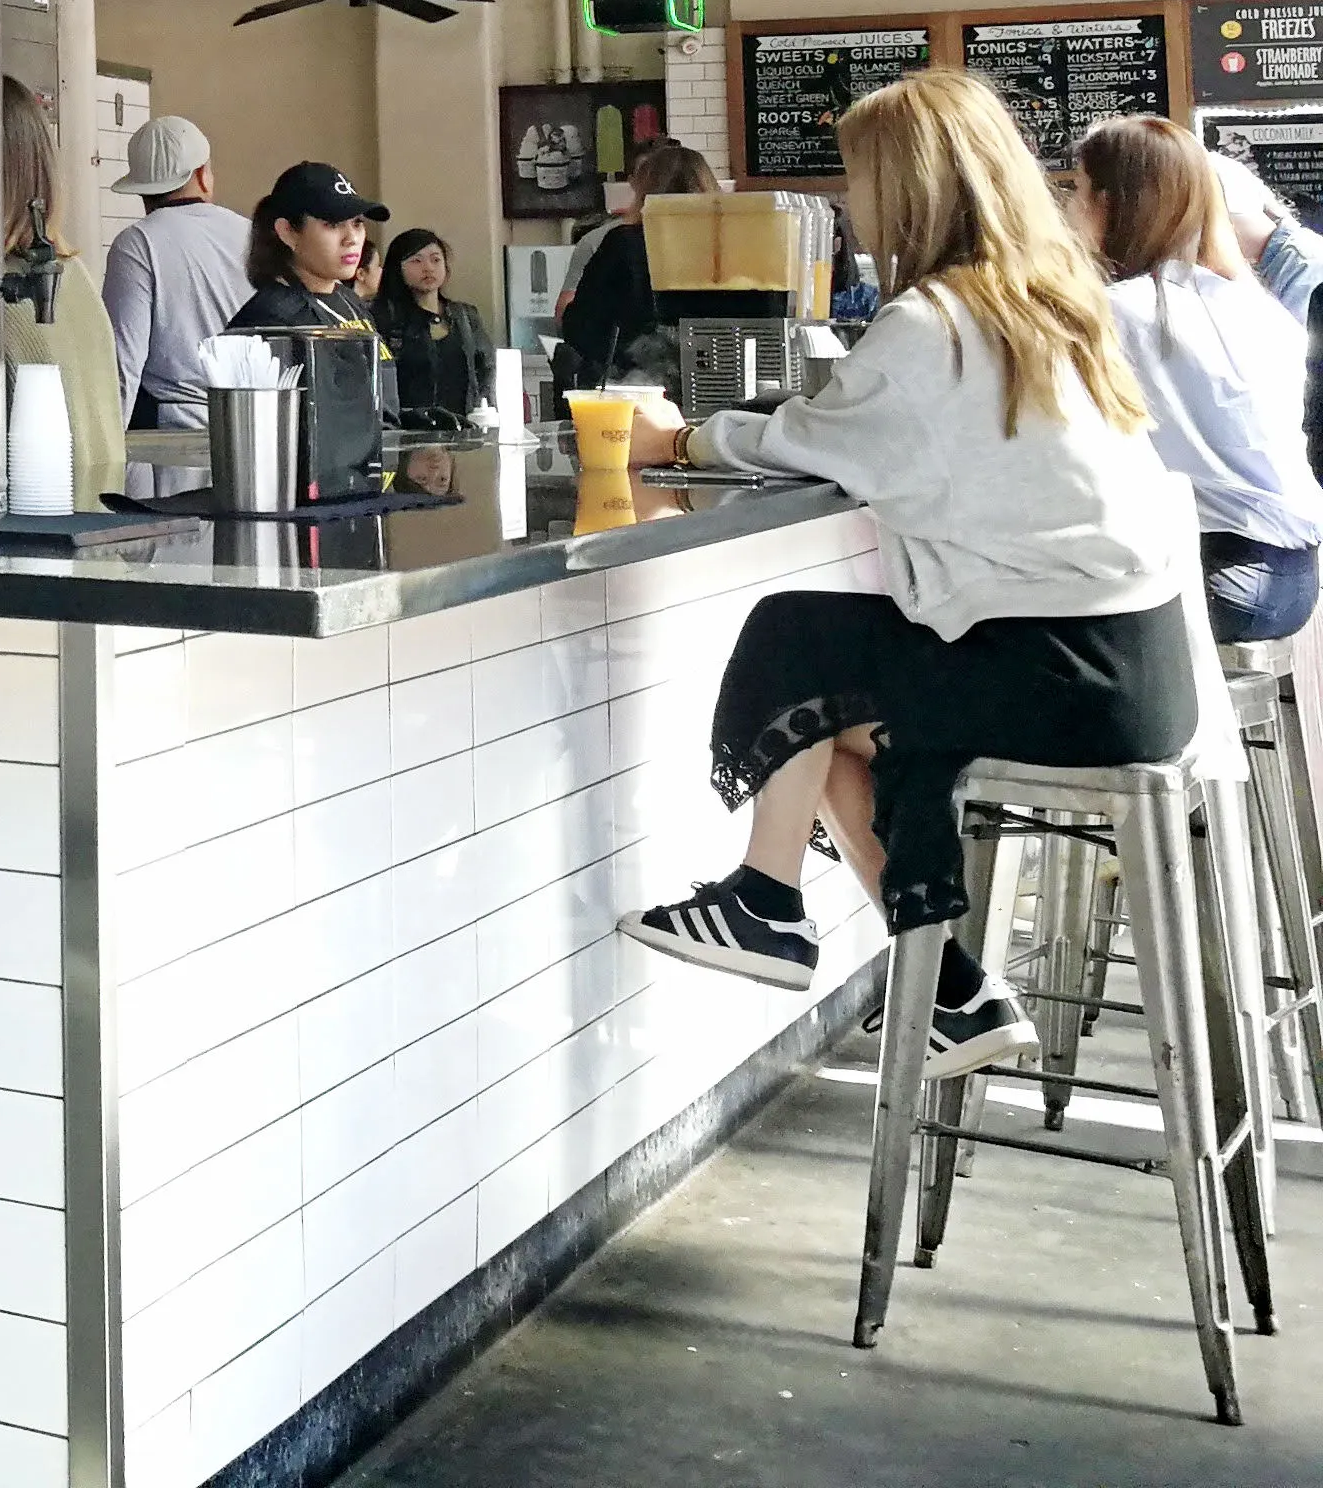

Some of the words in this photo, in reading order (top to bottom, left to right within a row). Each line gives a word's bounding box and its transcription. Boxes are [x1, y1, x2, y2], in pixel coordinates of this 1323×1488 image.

[1235, 8, 1259, 19] COLD
[1263, 6, 1304, 19] PRESSED
[1261, 18, 1316, 40] FREEZES
[855, 33, 914, 45] JUICES
[1067, 36, 1134, 50] WATERS
[850, 46, 917, 60] GREENS
[967, 41, 1027, 55] TONICS
[755, 49, 825, 63] SWEETS
[995, 56, 1033, 67] TONIC
[1067, 51, 1136, 63] KICKSTART
[1256, 47, 1323, 65] STRAWBERRY
[756, 66, 793, 77] LIQUID
[794, 64, 824, 75] GOLD
[849, 62, 901, 73] BALANCE
[1263, 63, 1318, 80] LEMONADE
[1067, 71, 1140, 83] CHLOROPHYLL
[756, 80, 801, 90] QUENCH
[756, 94, 793, 104] SWEET
[795, 93, 830, 103] GREEN
[757, 111, 812, 124] ROOTS
[759, 141, 821, 151] LONGEVITY
